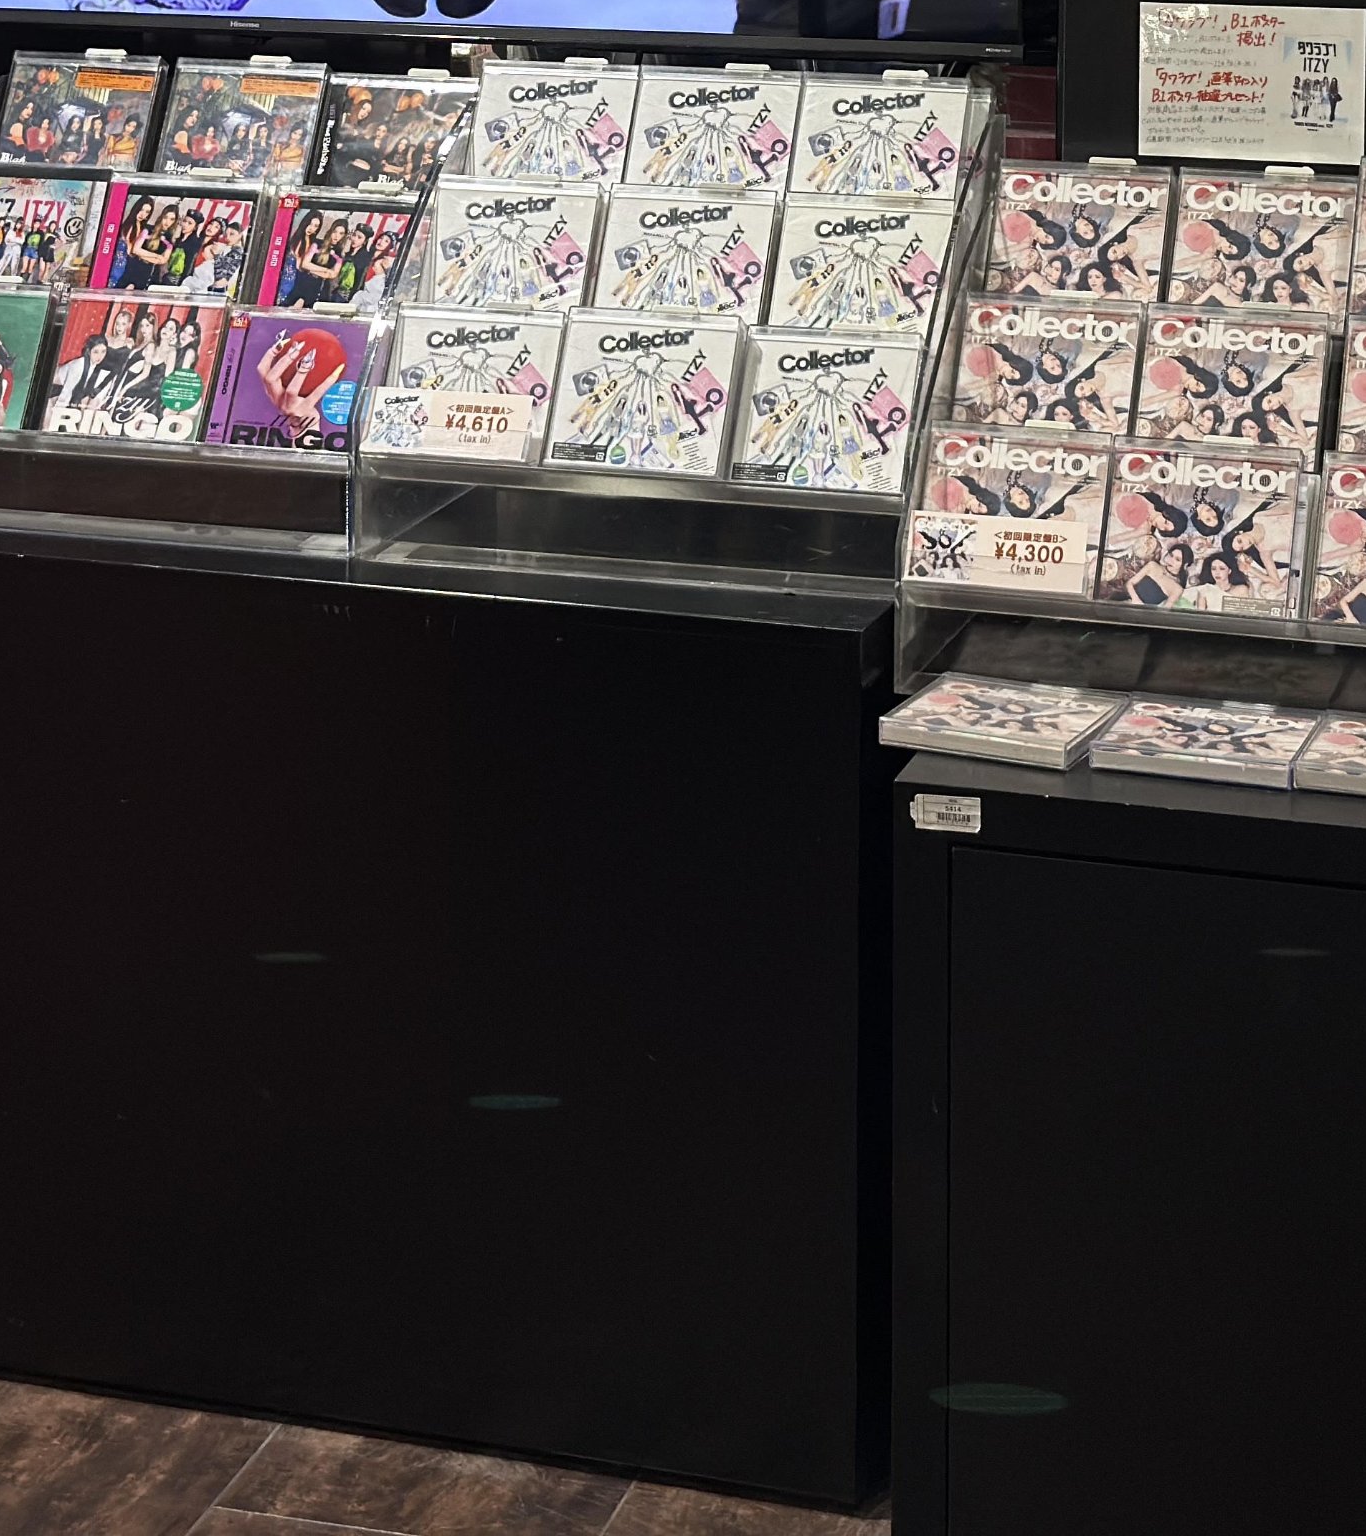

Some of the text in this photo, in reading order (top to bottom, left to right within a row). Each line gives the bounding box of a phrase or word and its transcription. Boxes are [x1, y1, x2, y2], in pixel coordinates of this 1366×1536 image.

[1303, 58, 1330, 73] ITZY
[508, 79, 598, 103] Collector
[669, 84, 760, 109] Collector
[832, 92, 925, 117] Collector
[585, 97, 609, 130] ITZY
[748, 103, 773, 135] ITZY
[913, 110, 938, 141] ITZY
[1003, 174, 1169, 208] Collector
[1186, 184, 1354, 219] Collector
[22, 197, 68, 230] ITZY
[465, 196, 556, 220] Collector
[638, 205, 733, 230] Collector
[542, 214, 568, 245] ITZY
[720, 224, 747, 257] ITZY
[814, 214, 910, 238] Collector
[898, 233, 923, 265] ITZY
[426, 324, 520, 348] Collector
[599, 328, 694, 353] Collector
[970, 307, 1137, 343] Collector
[1152, 320, 1325, 355] Collector
[506, 344, 532, 377] ITZY
[681, 348, 707, 382] ITZY
[778, 347, 875, 374] Collector
[862, 367, 888, 402] ITZY
[384, 396, 420, 406] Collector
[48, 405, 193, 441] RINGO
[230, 424, 350, 452] RINGO
[445, 414, 509, 434] ¥4,610
[934, 439, 1107, 477] Collector
[1119, 452, 1297, 493] Collector
[994, 541, 1064, 565] ¥4,300
